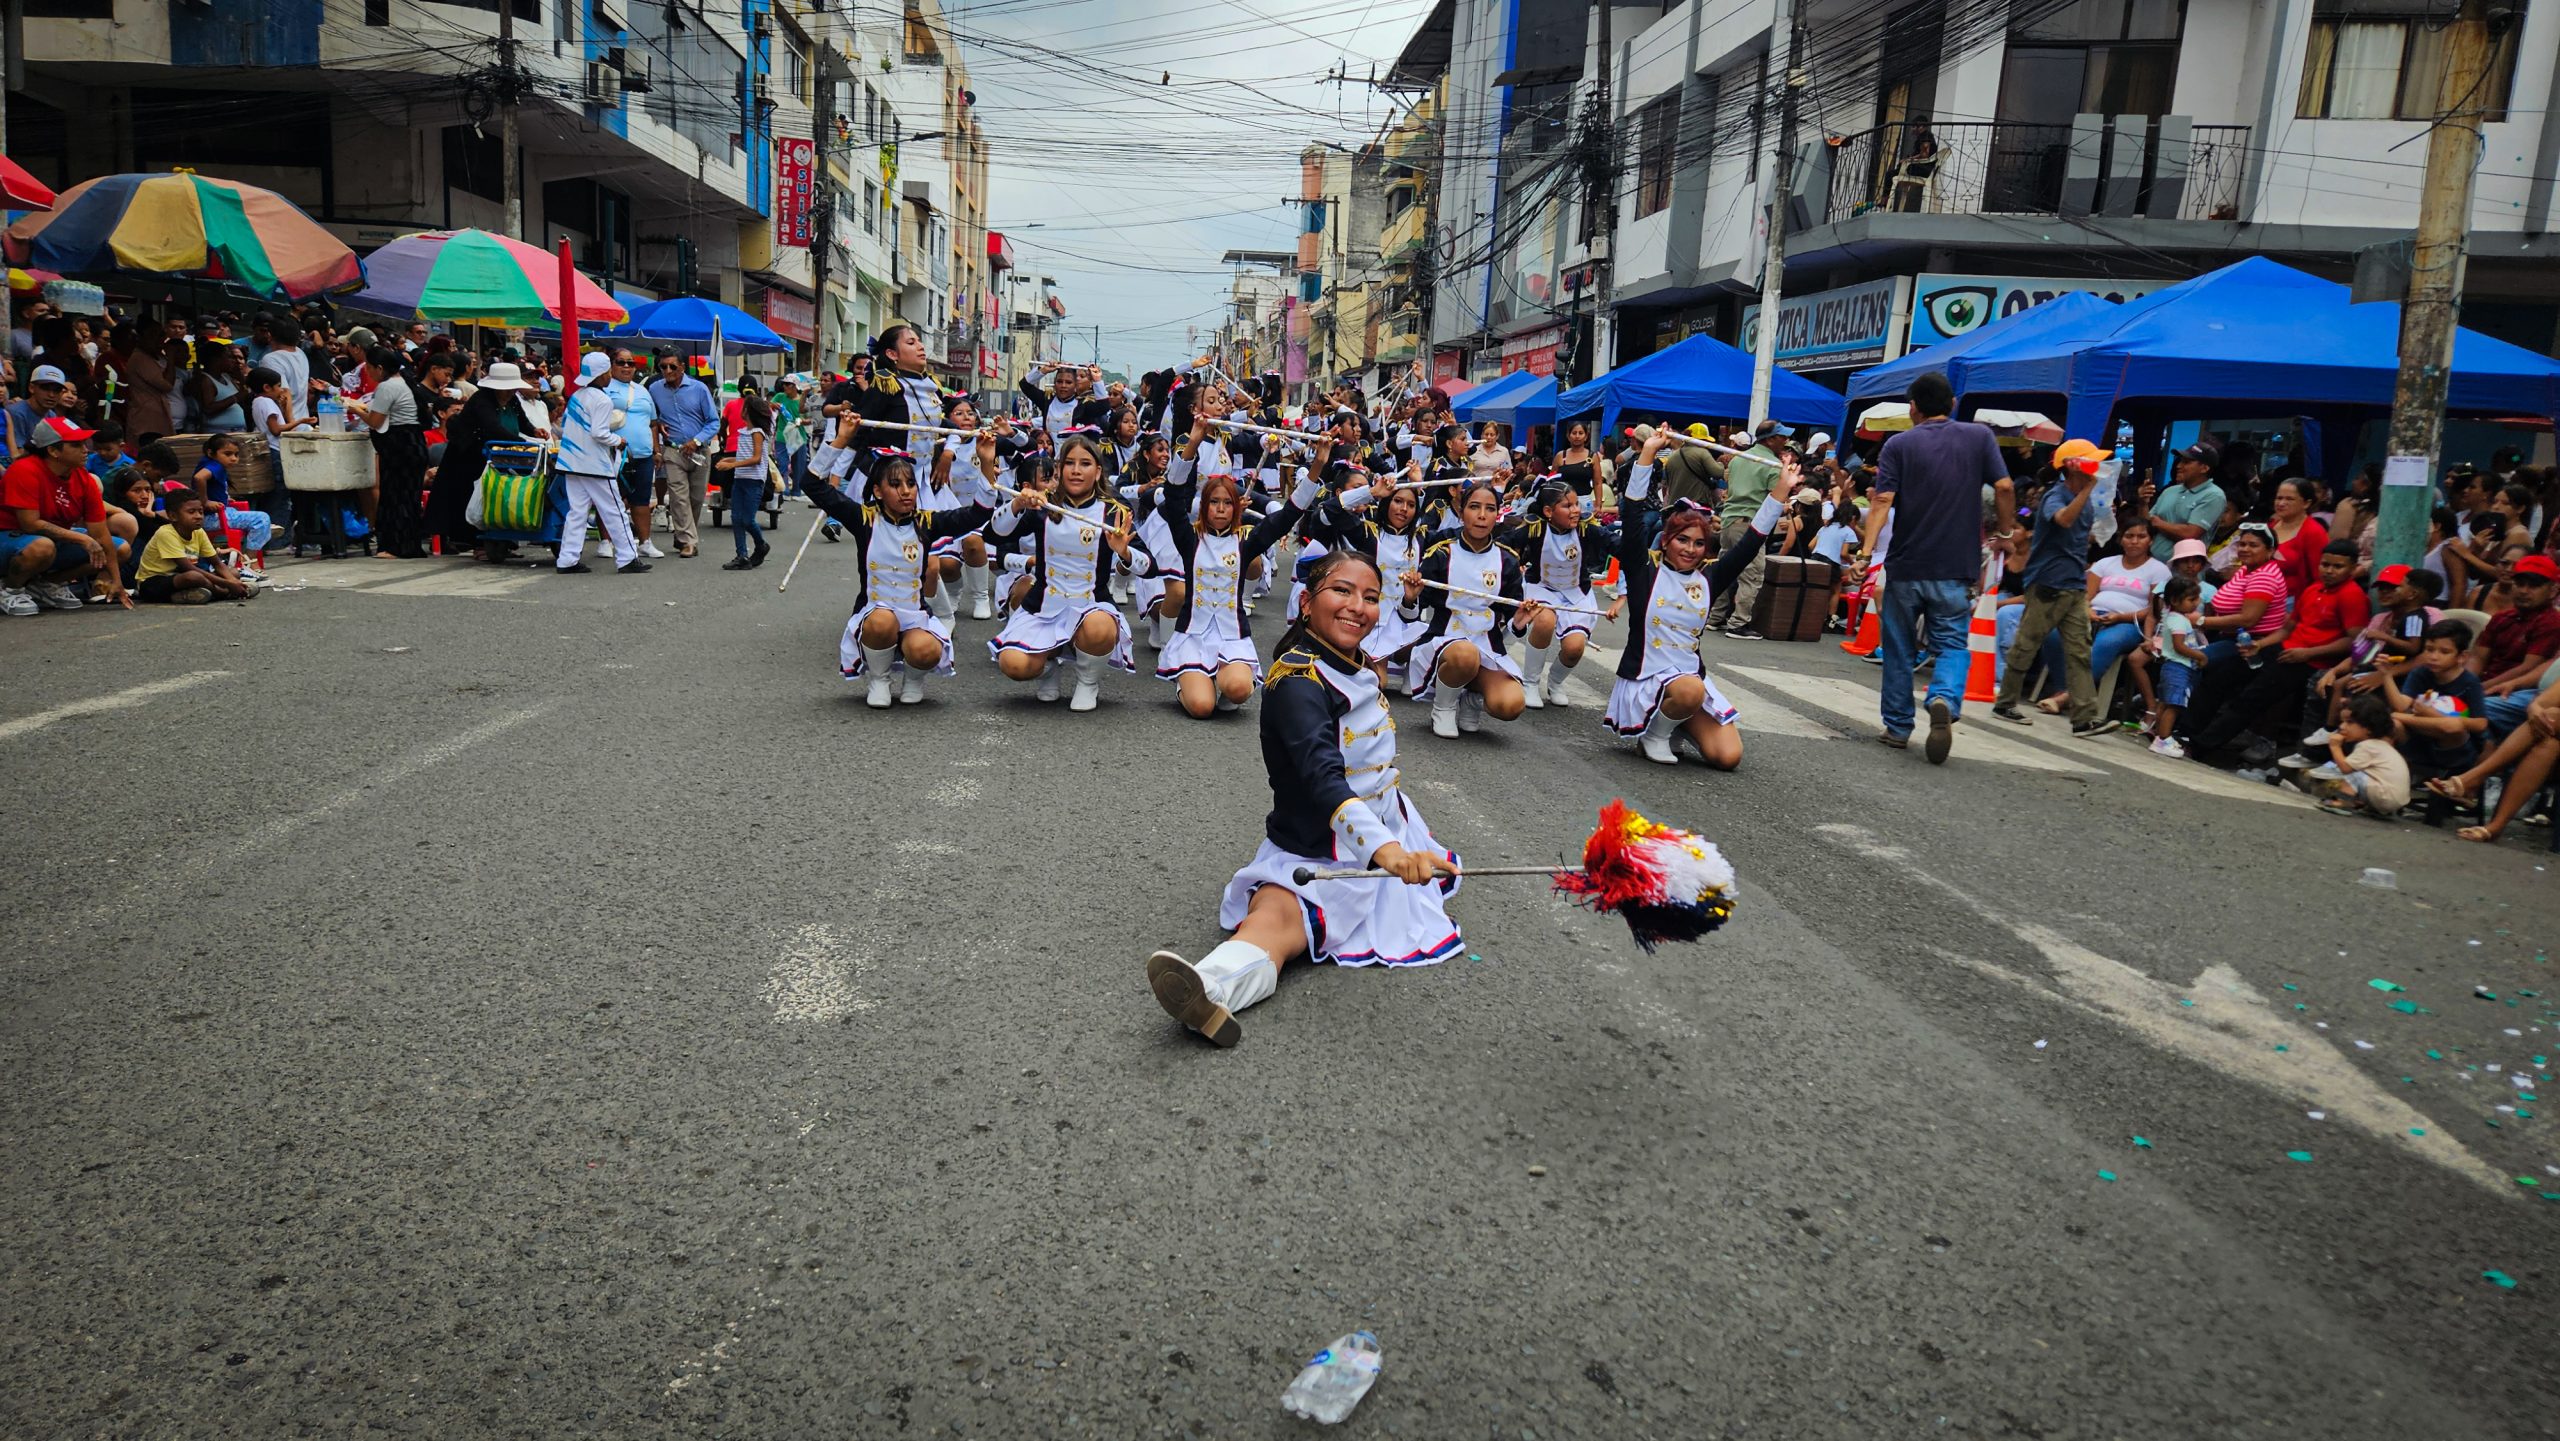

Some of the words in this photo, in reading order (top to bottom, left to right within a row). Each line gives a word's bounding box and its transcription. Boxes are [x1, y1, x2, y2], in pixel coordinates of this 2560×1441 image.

[779, 140, 793, 244] farmacias
[795, 168, 808, 240] suiza
[1691, 316, 1715, 331] GOLDEN
[1777, 304, 1809, 351] PTICA
[1811, 290, 1889, 346] MEGALENS
